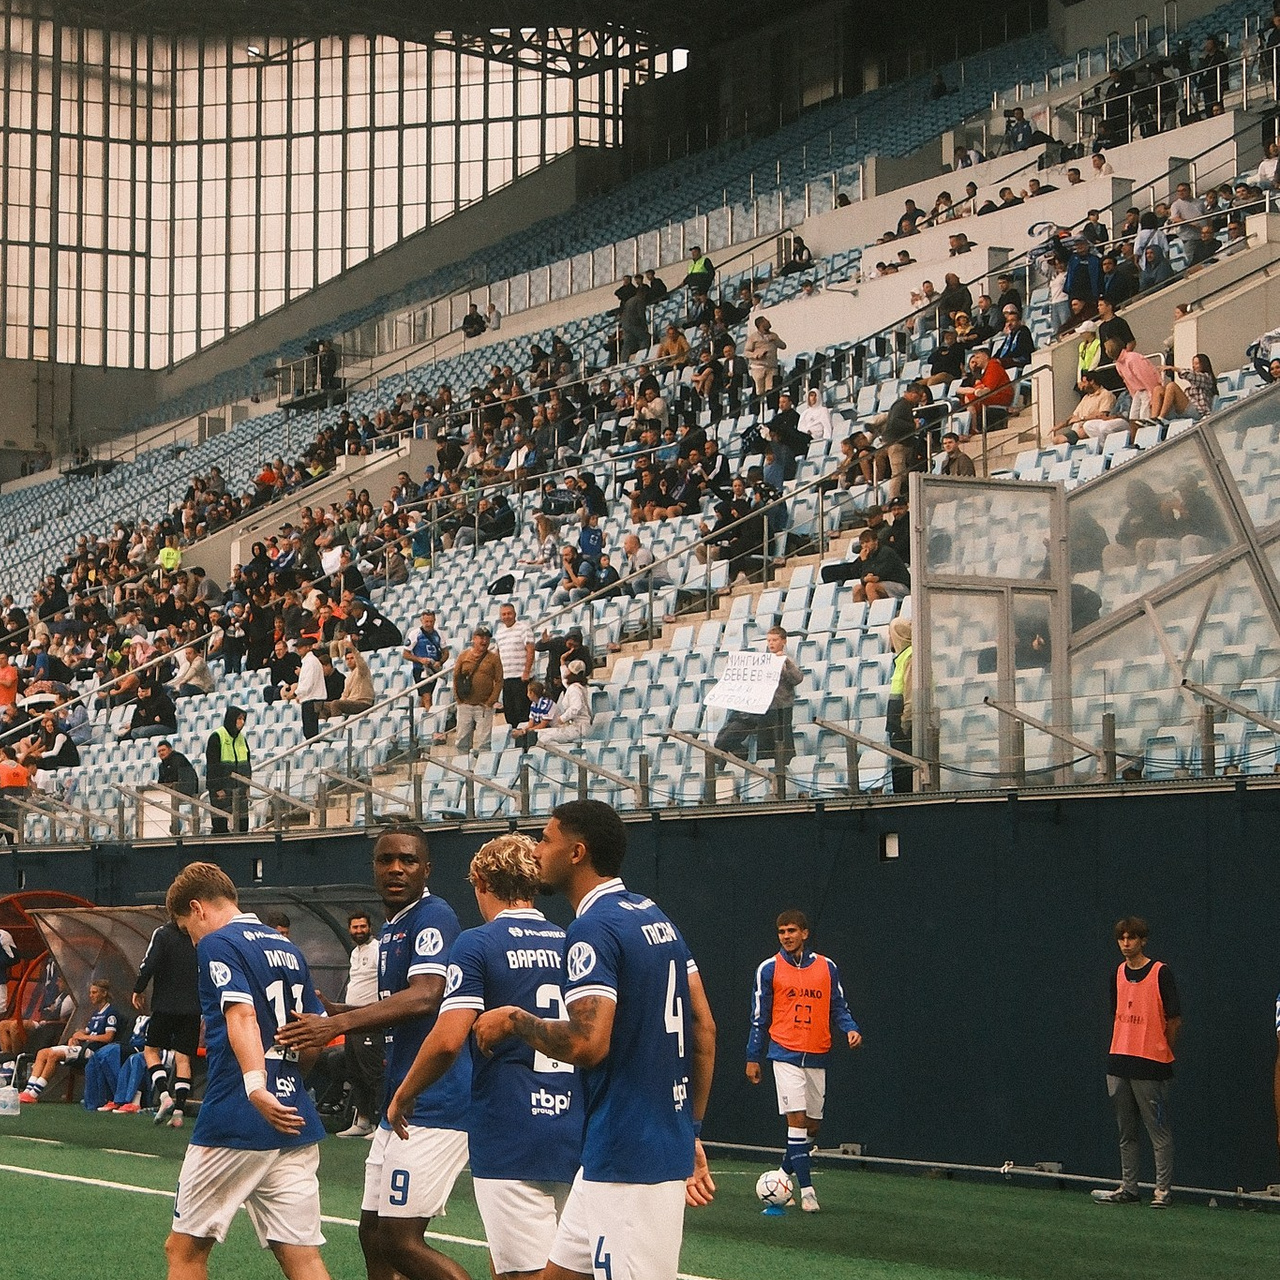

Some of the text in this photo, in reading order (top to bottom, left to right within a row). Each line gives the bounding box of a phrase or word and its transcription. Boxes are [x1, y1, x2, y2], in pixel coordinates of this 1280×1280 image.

[664, 960, 685, 1058] 4
[799, 988, 823, 999] JAKO
[389, 1169, 410, 1206] 9
[594, 1235, 612, 1280] 4
